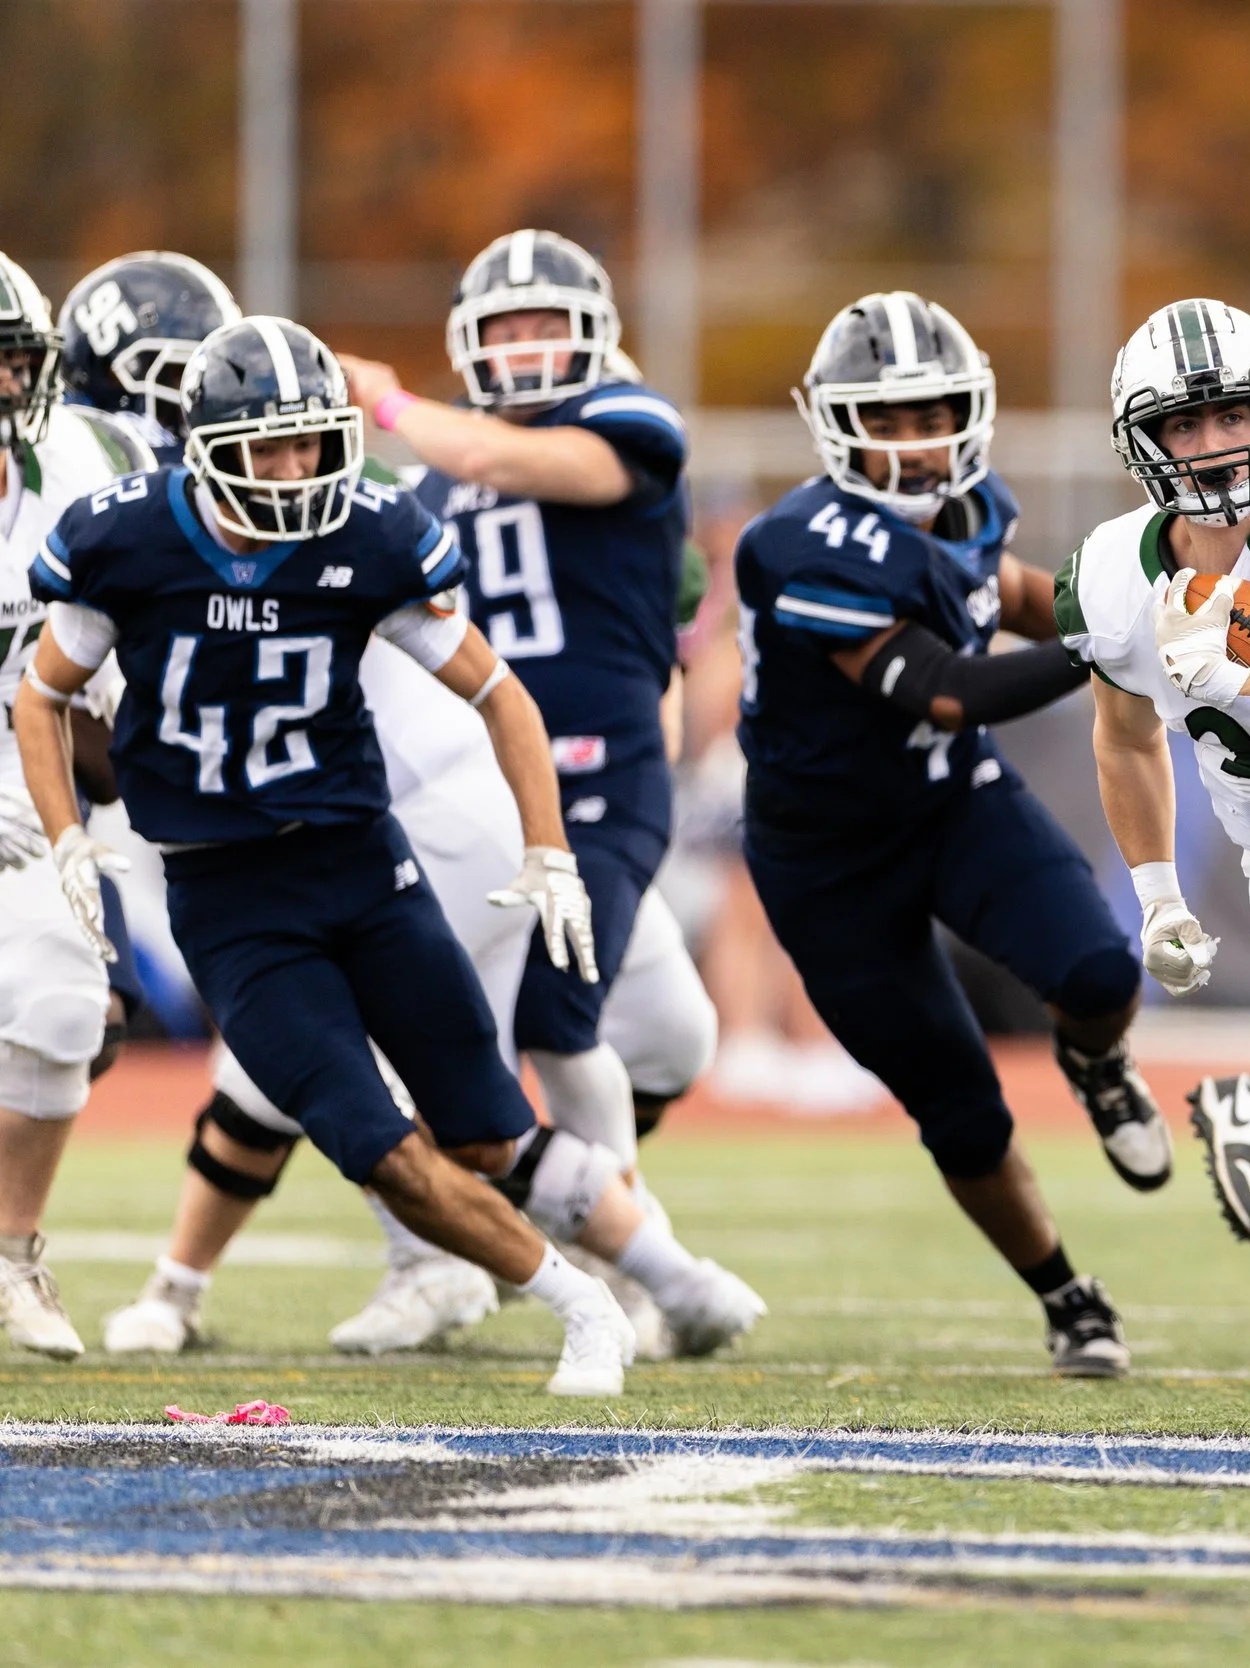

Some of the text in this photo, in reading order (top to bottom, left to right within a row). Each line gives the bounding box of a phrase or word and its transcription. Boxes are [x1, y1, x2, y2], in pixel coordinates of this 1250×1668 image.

[809, 502, 890, 563] 44
[207, 594, 279, 632] OWLS
[159, 635, 333, 794] 42
